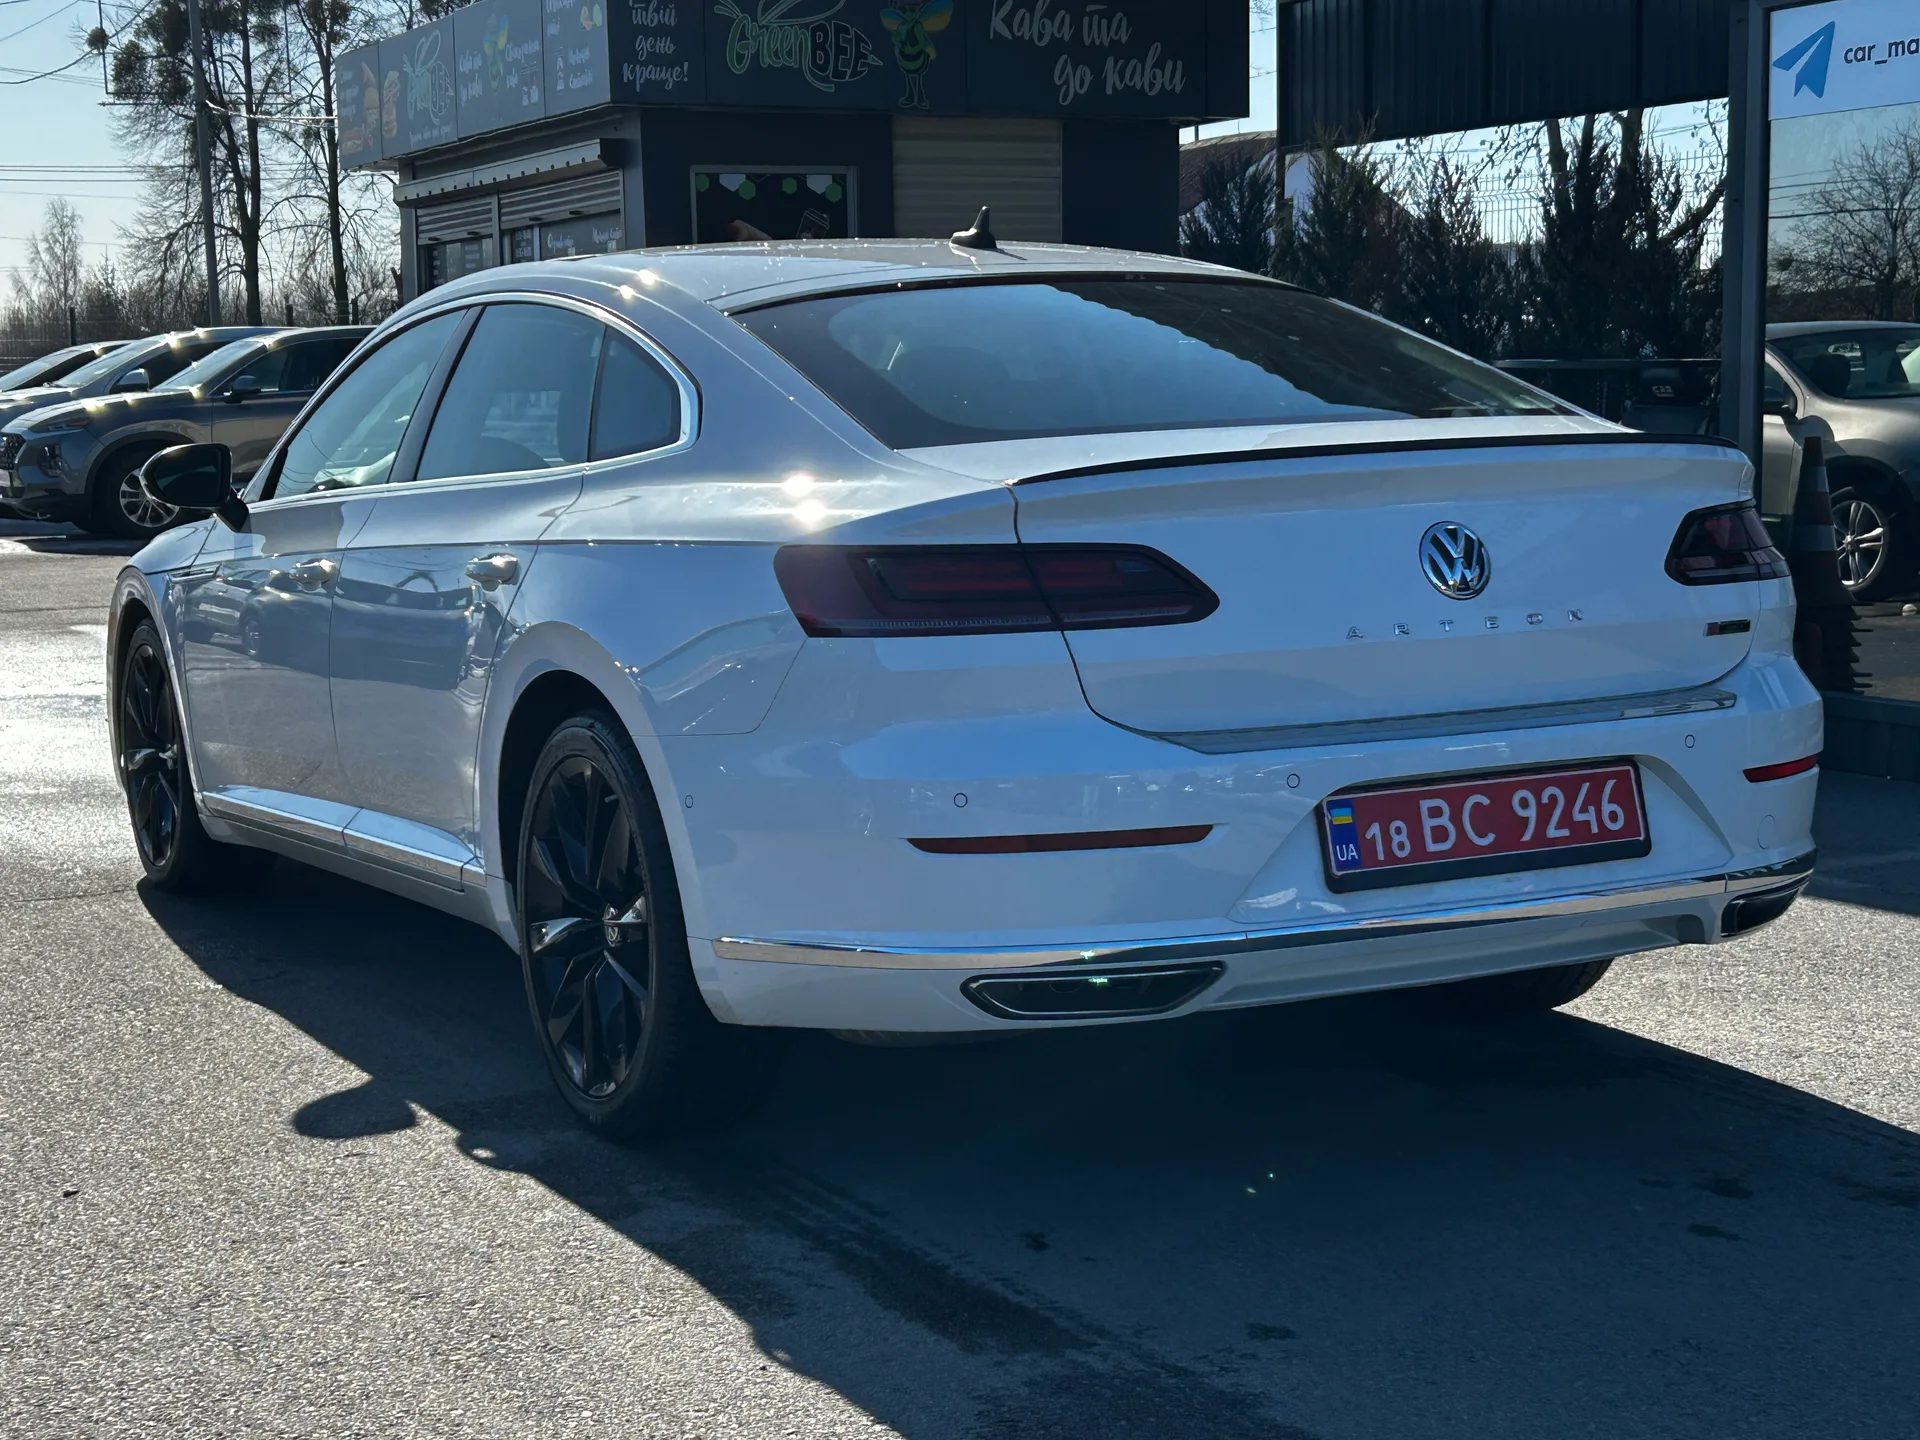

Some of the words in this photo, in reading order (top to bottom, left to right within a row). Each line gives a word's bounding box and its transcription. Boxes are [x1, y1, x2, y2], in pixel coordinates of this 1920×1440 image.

[632, 0, 677, 27] твій
[990, 0, 1074, 46] Кава
[1083, 5, 1131, 47] та
[635, 34, 676, 61] день
[1844, 38, 1920, 65] car_ma
[621, 61, 689, 92] краще!
[1053, 54, 1094, 105] до
[1102, 42, 1186, 96] кави
[1346, 608, 1583, 639] ARTEON
[1364, 820, 1411, 861] 18
[1418, 794, 1496, 852] BC
[1511, 779, 1624, 842] 9246
[1336, 843, 1358, 861] UA
